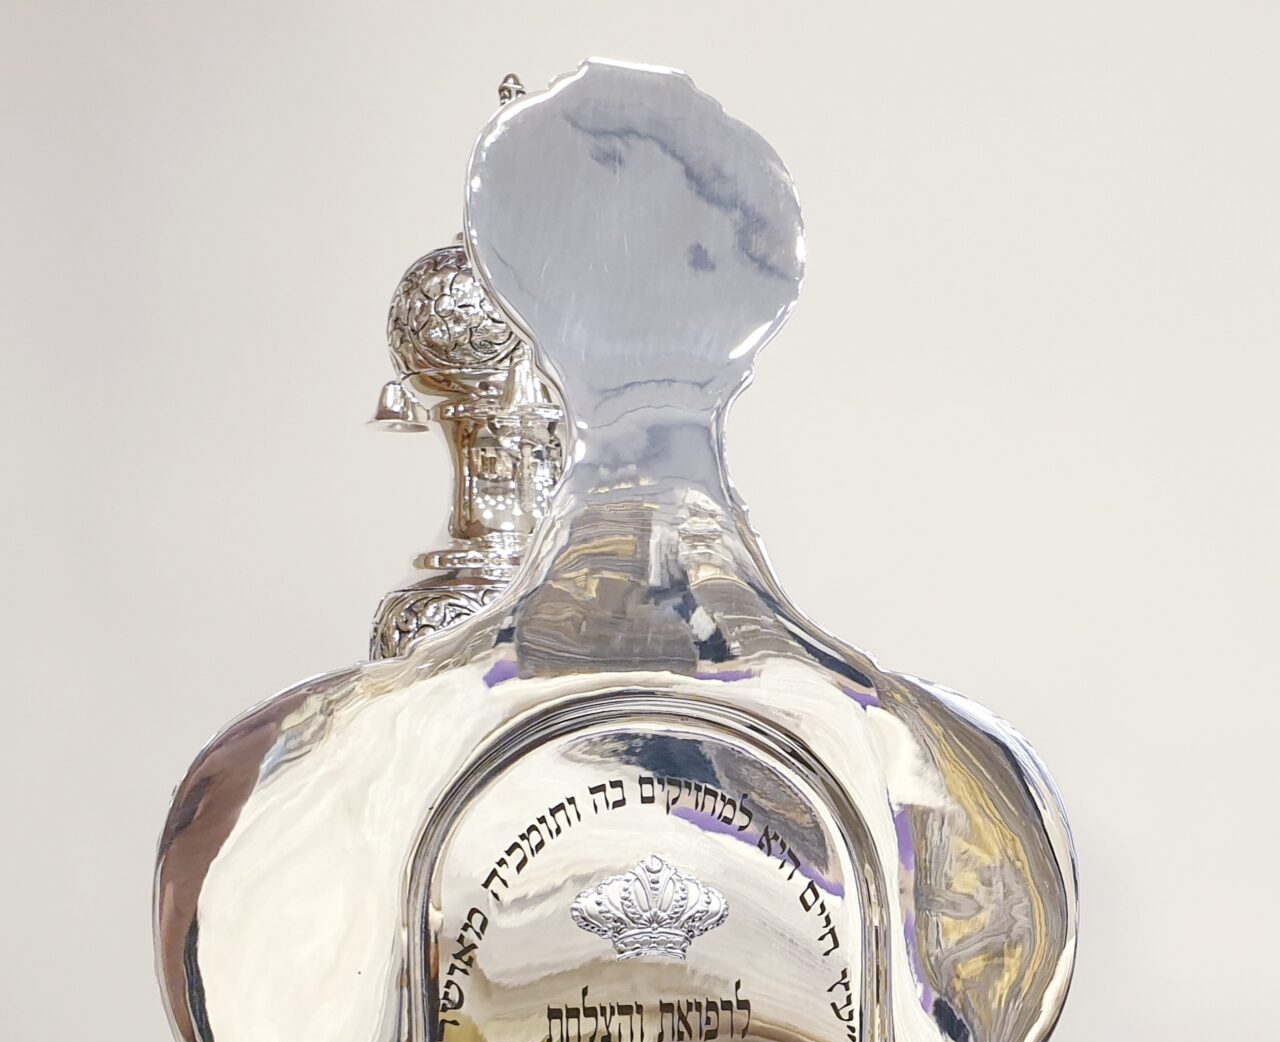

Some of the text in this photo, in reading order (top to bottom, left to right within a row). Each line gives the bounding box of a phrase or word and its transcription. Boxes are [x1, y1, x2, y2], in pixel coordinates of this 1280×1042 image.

[588, 779, 627, 813] בה
[638, 775, 755, 831] למחזיקים
[481, 797, 584, 901] ותומכיה
[757, 825, 802, 881] היא
[799, 880, 840, 956] חיים
[657, 980, 752, 1042] לרפואת
